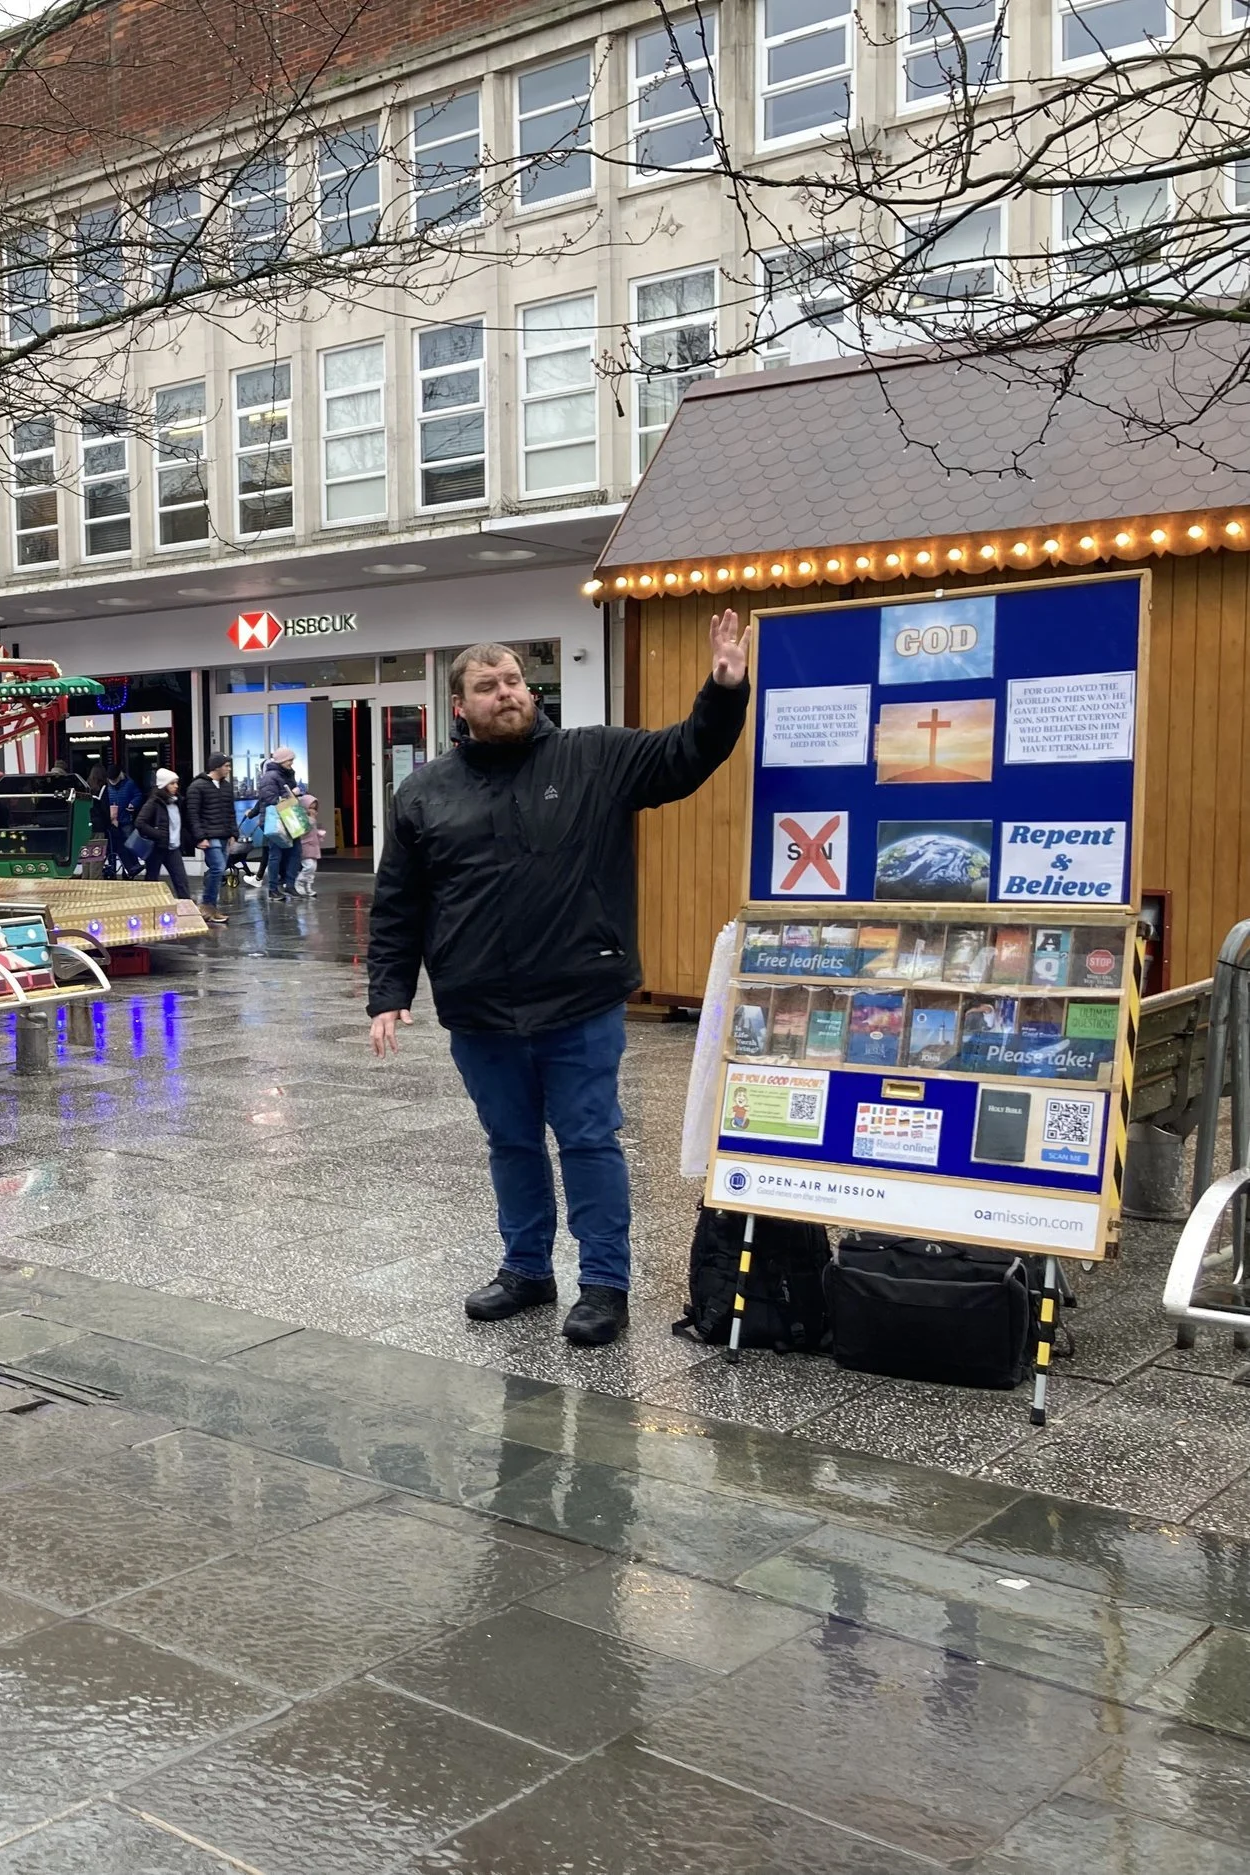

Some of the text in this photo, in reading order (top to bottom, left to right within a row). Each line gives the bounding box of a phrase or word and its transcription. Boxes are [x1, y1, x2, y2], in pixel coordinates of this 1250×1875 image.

[284, 614, 356, 636] HSBC UK
[894, 624, 978, 658] GOD
[1044, 686, 1065, 694] GOD
[1066, 684, 1098, 693] LOVED
[1099, 683, 1118, 691] THE
[1016, 696, 1049, 705] WORLD
[1064, 694, 1085, 703] THIS
[1014, 702, 1128, 715] GAVE HIS ONE AND ONLY
[1036, 716, 1048, 724] SO
[1050, 714, 1076, 722] THAT
[1077, 712, 1127, 721] EVERYONE
[1019, 726, 1042, 734] WHO
[1044, 723, 1086, 732] BELIEVES
[1019, 735, 1041, 744] WILL
[1064, 733, 1098, 741] PERISH
[1022, 745, 1047, 753] HAVE
[1049, 743, 1092, 752] ETERNAL
[1008, 825, 1116, 849] Repent
[1050, 853, 1073, 872] &
[1003, 875, 1112, 897] Believe
[756, 952, 844, 970] Free leaflets
[1089, 957, 1112, 967] STOP
[1072, 1018, 1115, 1028] QUESTIONS
[921, 1052, 940, 1062] JOHN
[986, 1046, 1094, 1068] Please take!
[731, 1073, 744, 1082] ARE
[745, 1074, 759, 1083] YOU
[766, 1076, 789, 1085] GOOD
[790, 1077, 824, 1087] PERSON?
[988, 1105, 1022, 1114] HOLY BIBLE
[876, 1139, 936, 1154] Read online!
[1048, 1152, 1068, 1161] SCAN
[758, 1175, 886, 1199] OPEN-AIR MISSION
[974, 1209, 1084, 1232] oamission.com
